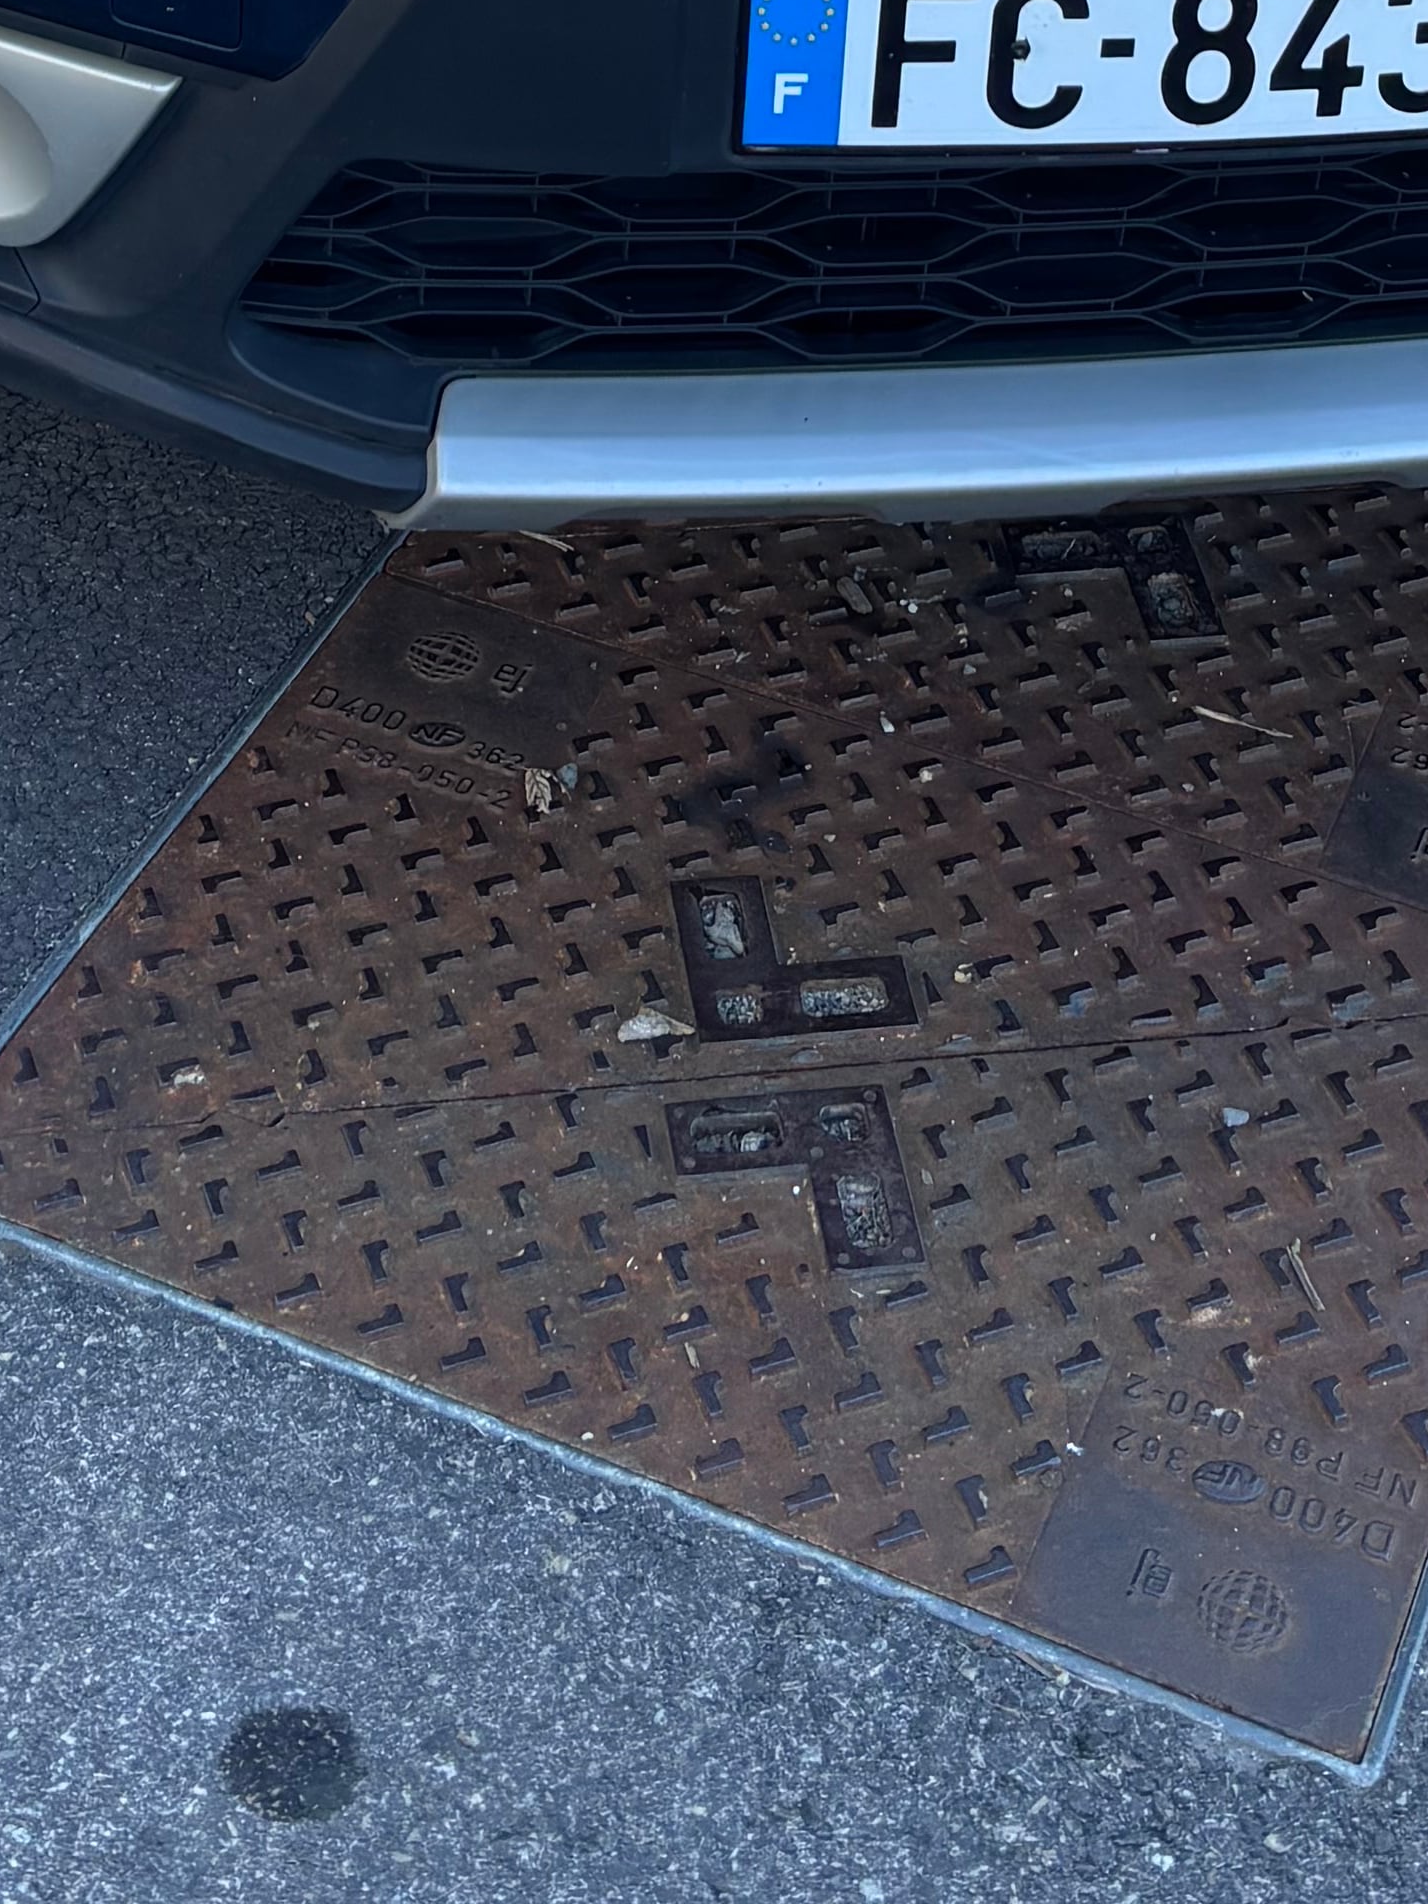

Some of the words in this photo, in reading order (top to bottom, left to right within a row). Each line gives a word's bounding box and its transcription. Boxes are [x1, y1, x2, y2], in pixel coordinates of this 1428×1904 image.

[772, 74, 809, 116] F
[310, 685, 407, 730] D400
[412, 723, 465, 743] NF
[467, 740, 525, 772] 362
[1112, 1425, 1188, 1472] 362
[1354, 1467, 1417, 1507] NF
[1269, 1485, 1395, 1562] D400
